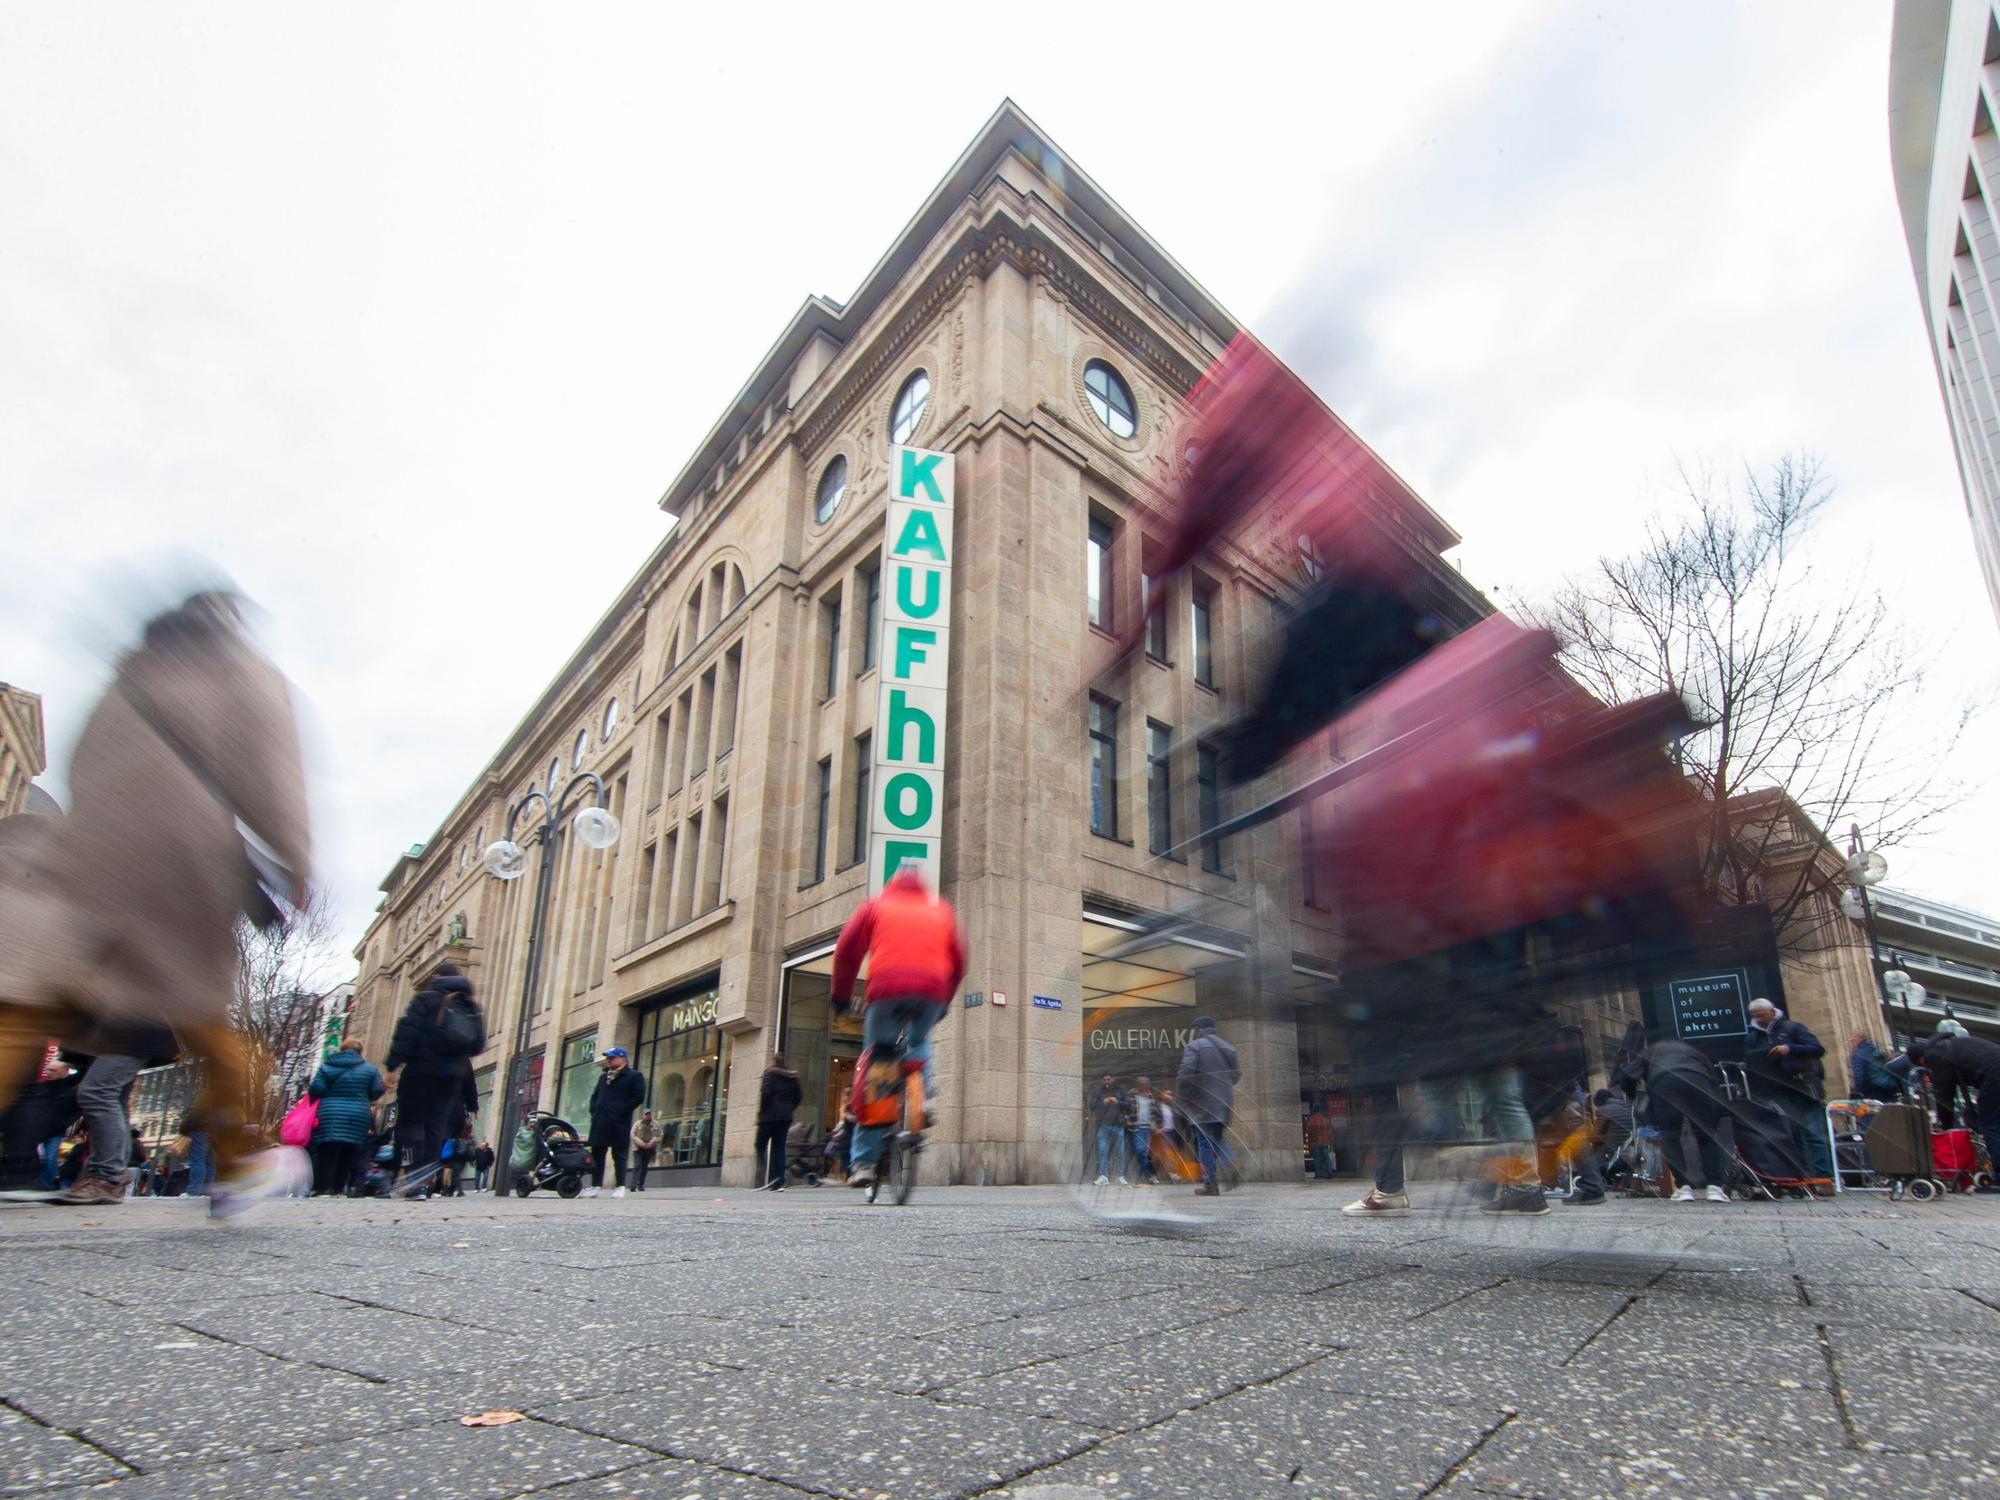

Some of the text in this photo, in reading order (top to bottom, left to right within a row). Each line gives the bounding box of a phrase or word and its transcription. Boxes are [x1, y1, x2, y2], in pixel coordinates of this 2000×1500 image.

[1678, 982, 1731, 995] museum
[1680, 997, 1694, 1007] of
[1682, 1008, 1732, 1019] modern
[1684, 1022, 1720, 1032] ahrts
[1090, 1029, 1172, 1050] GALERIA
